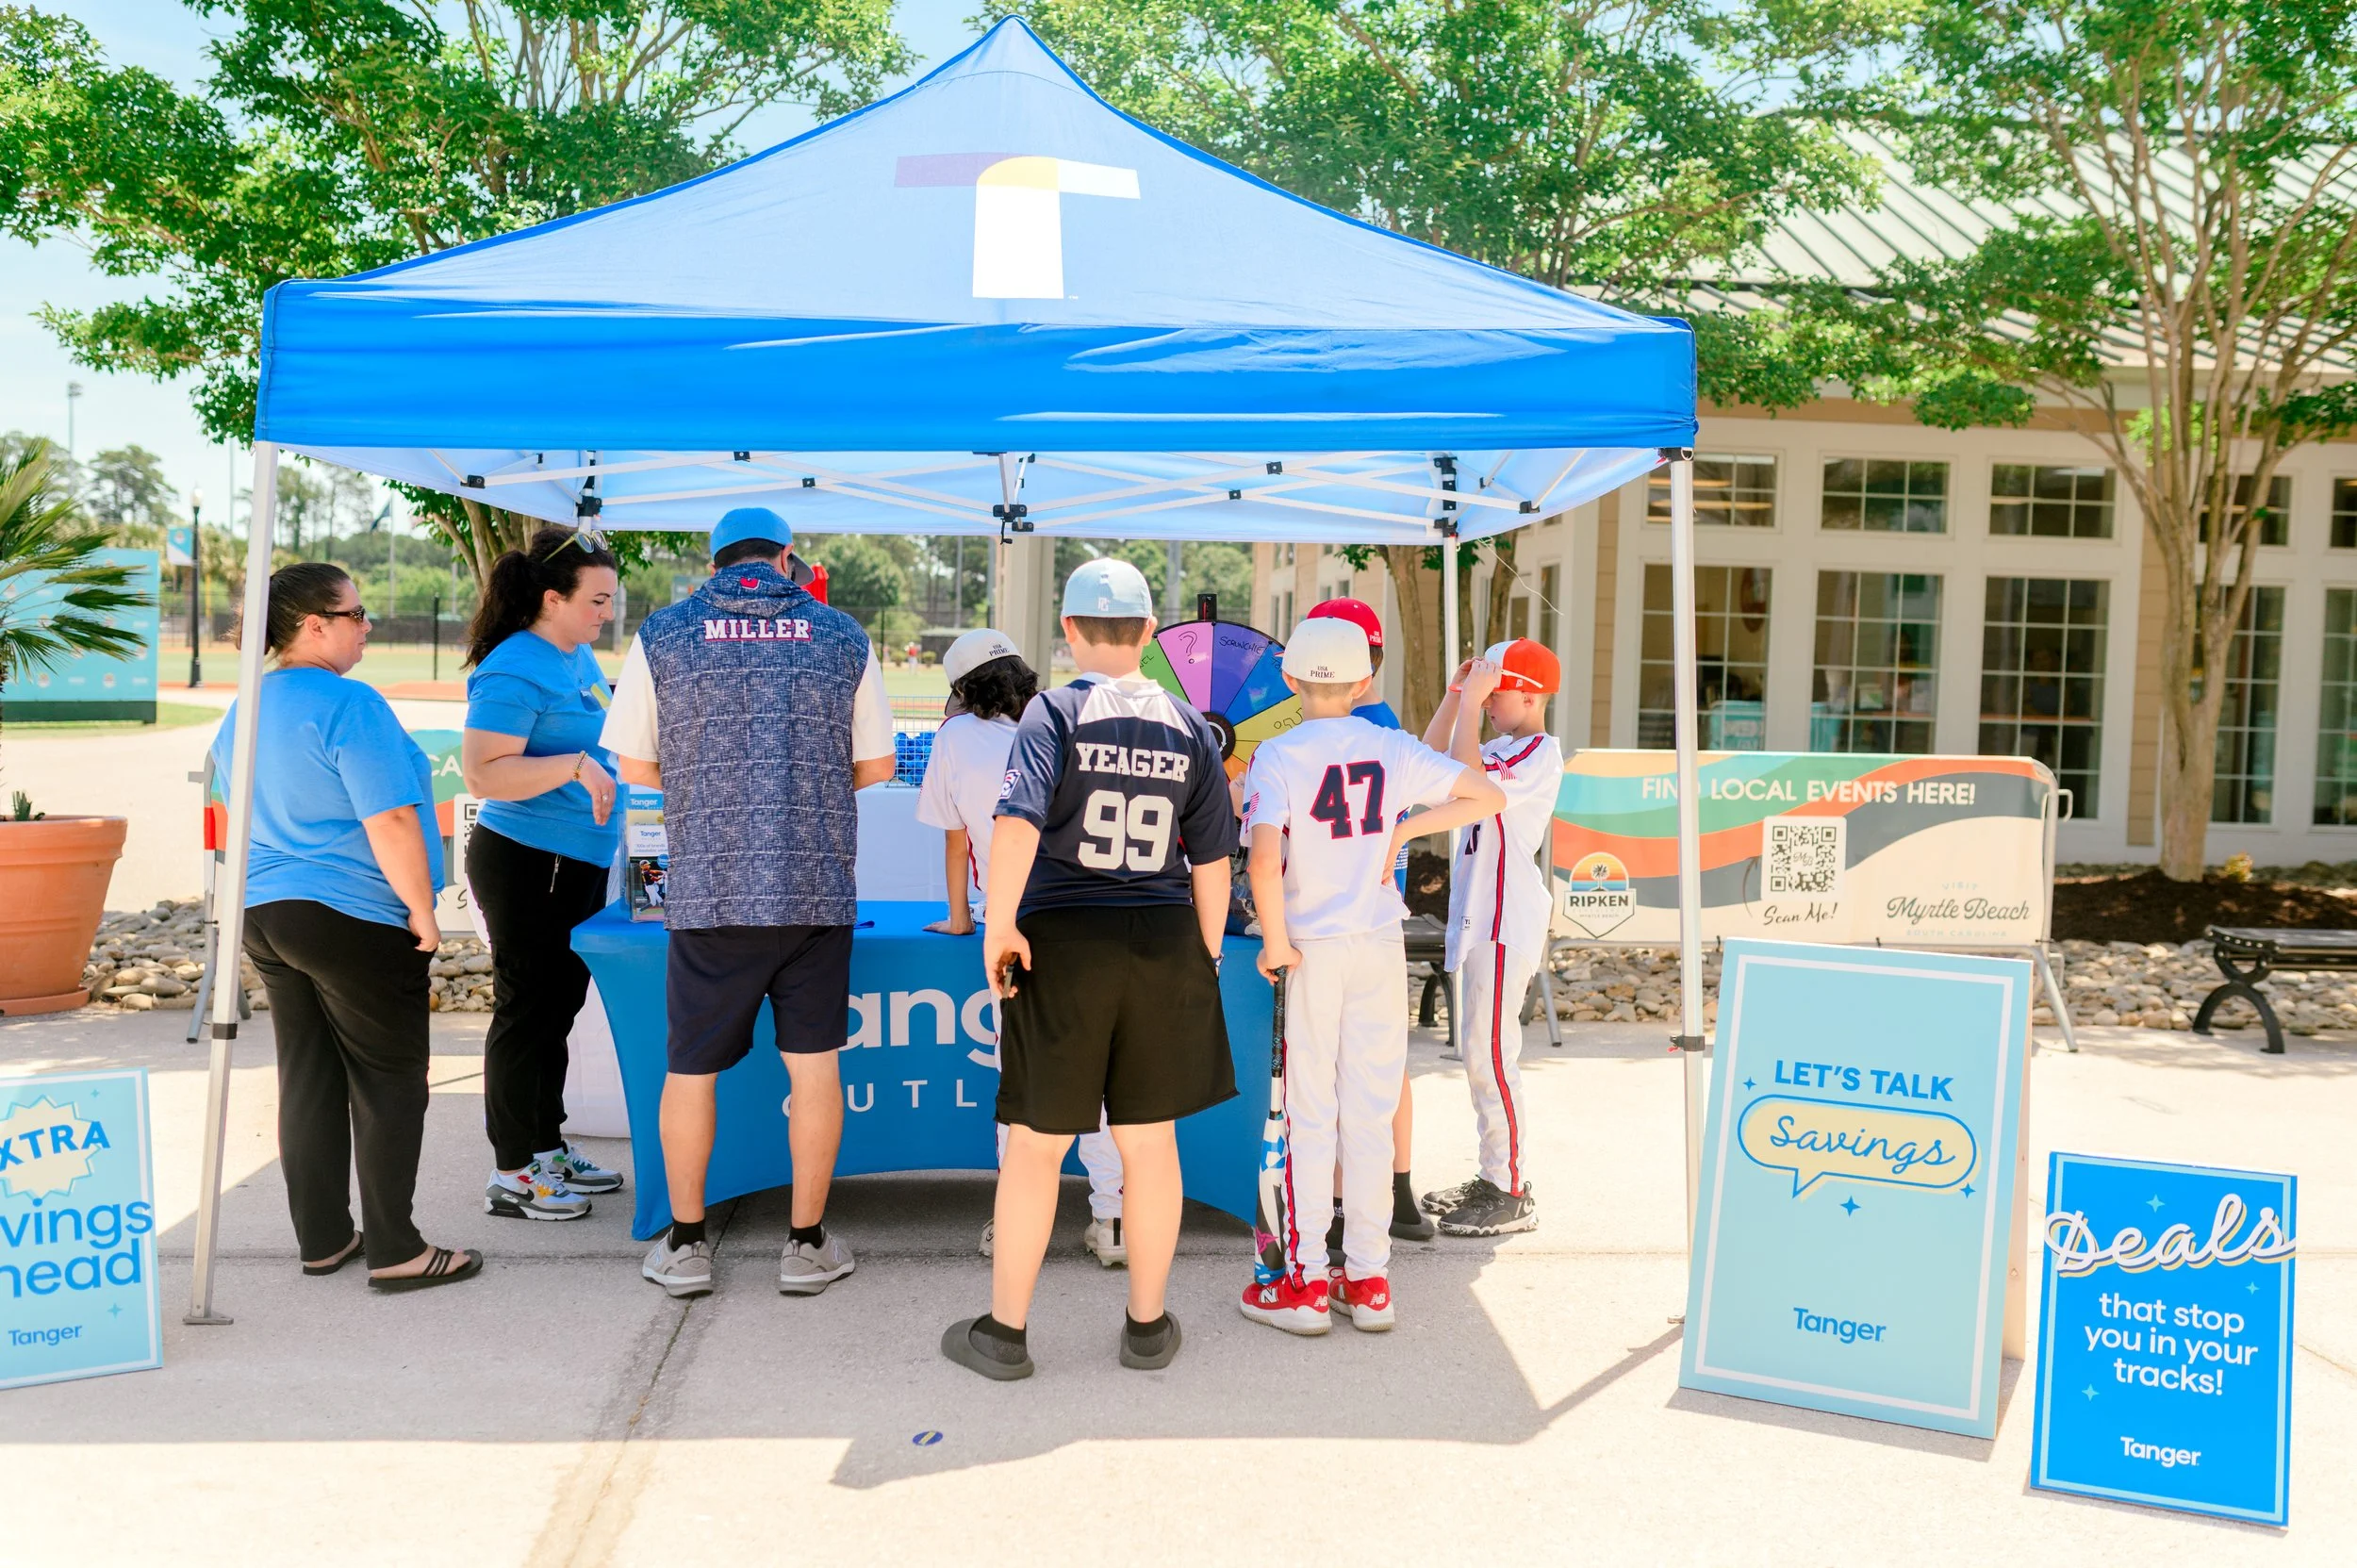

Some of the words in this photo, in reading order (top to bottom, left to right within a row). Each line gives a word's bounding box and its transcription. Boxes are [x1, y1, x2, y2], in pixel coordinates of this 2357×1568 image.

[703, 618, 812, 641] MILLER
[1219, 635, 1264, 654] SCRUNCHIE
[989, 648, 1011, 656] PRIME
[1075, 742, 1190, 783] YEAGER
[630, 799, 658, 807] Tanger
[1310, 760, 1386, 839] 47
[1641, 777, 1701, 800] FIN
[1711, 778, 1798, 801] LOCAL
[1806, 780, 1898, 803] EVENTS
[1907, 782, 1976, 805] HERE!
[1078, 789, 1175, 872] 99
[1570, 895, 1629, 907] RIPKEN
[1763, 905, 1801, 926] Scan
[1805, 902, 1838, 924] Me!
[1887, 896, 1960, 925] Myrtle
[1964, 897, 2030, 920] Beach
[838, 988, 997, 1068] ang
[1773, 1060, 1861, 1091] LET'S
[1871, 1069, 1953, 1102] TALK
[0, 1120, 111, 1172] XTRA
[1770, 1114, 1956, 1175] Savings
[0, 1198, 154, 1249] vings
[2044, 1193, 2296, 1277] Deals
[1793, 1307, 1887, 1345] Tanger
[2099, 1293, 2167, 1324] that
[2173, 1302, 2245, 1338] stop
[8, 1325, 82, 1346] Tanger
[2085, 1325, 2141, 1351] you
[2150, 1327, 2176, 1356] in
[2184, 1338, 2258, 1365] your
[2114, 1357, 2224, 1395] tracks!
[2120, 1436, 2201, 1468] Tanger
